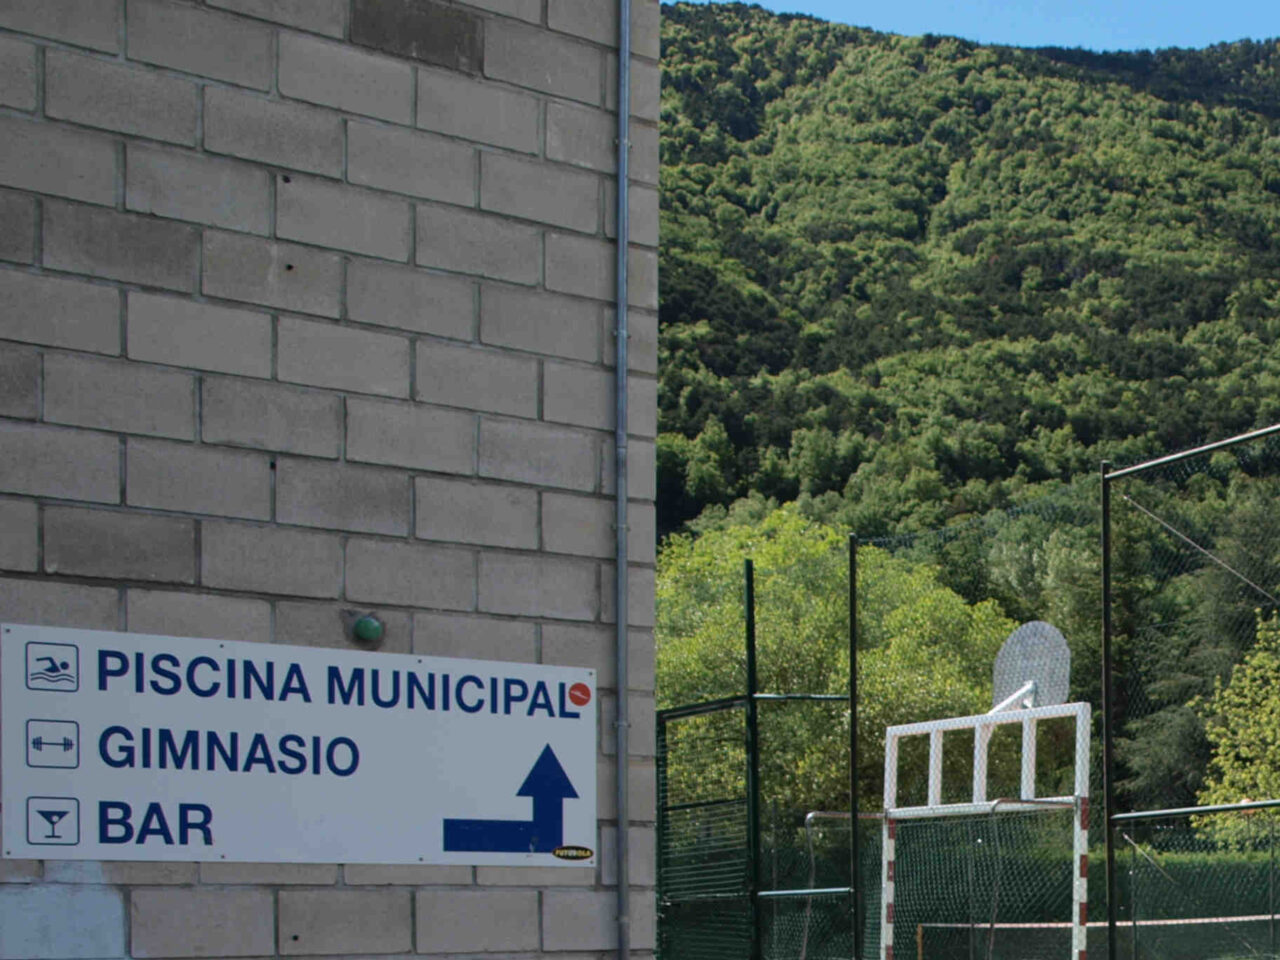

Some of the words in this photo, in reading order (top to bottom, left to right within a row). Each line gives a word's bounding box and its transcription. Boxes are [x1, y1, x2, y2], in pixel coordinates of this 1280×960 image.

[98, 649, 311, 702] PISCINA
[327, 666, 580, 718] MUNICIPAL
[99, 726, 359, 776] GIMNASIO
[98, 801, 213, 845] BAR
